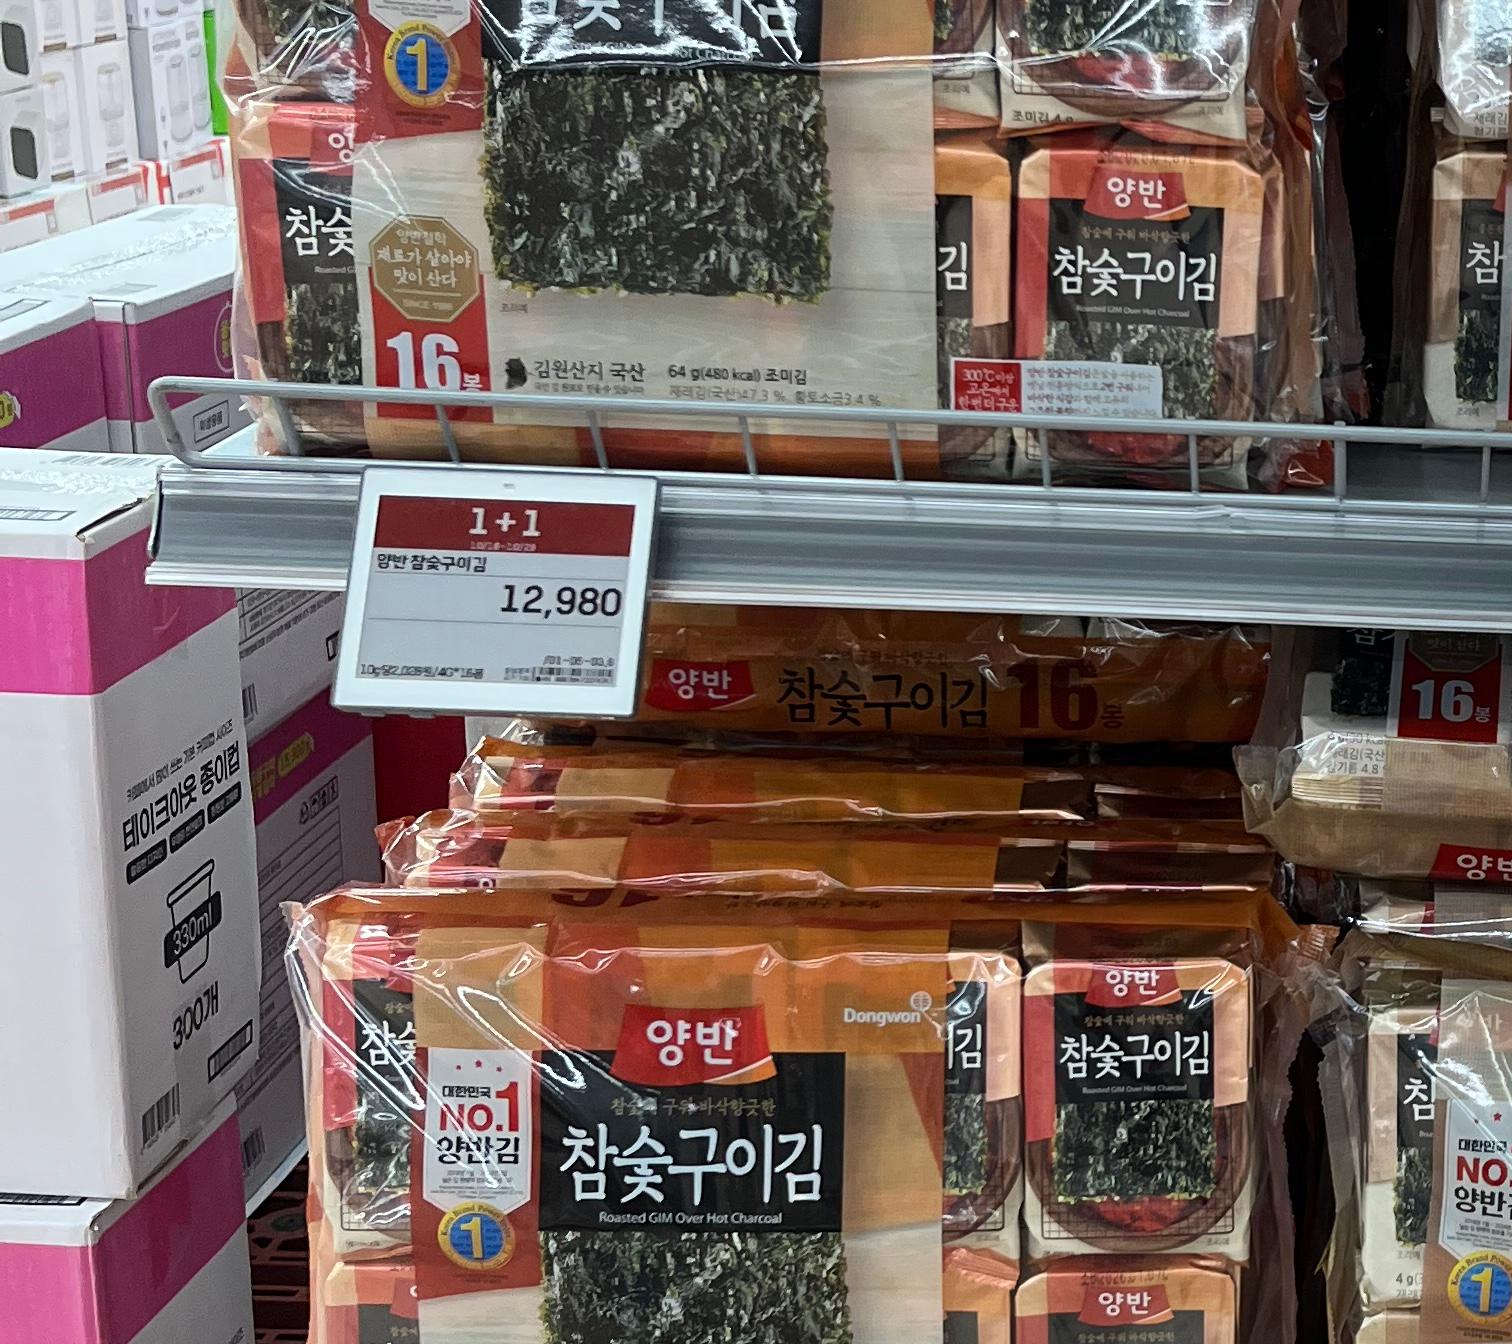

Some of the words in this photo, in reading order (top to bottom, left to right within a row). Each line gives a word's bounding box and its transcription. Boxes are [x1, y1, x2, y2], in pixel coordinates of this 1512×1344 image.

[1053, 246, 1218, 302] 참숯구이김
[534, 360, 603, 383] 김원산지
[610, 361, 646, 382] 국산
[469, 507, 541, 537] 1+1
[377, 553, 409, 570] 양반
[411, 554, 487, 573] 참숯구이김
[501, 584, 623, 619] 12,980
[122, 772, 198, 852] 테이크아웃
[200, 740, 241, 795] 종이컵
[172, 901, 216, 957] 330ml
[172, 980, 220, 1051] 300개
[843, 1006, 921, 1027] Dongwon
[1060, 1033, 1211, 1080] 참숯구이김
[441, 1084, 492, 1099] 대한민국
[560, 1122, 823, 1205] 참숯구이김
[599, 1210, 645, 1225] Roasted
[648, 1211, 674, 1225] GIM
[676, 1211, 704, 1226] Over
[708, 1211, 728, 1226] Hot
[731, 1211, 782, 1226] Charcoal
